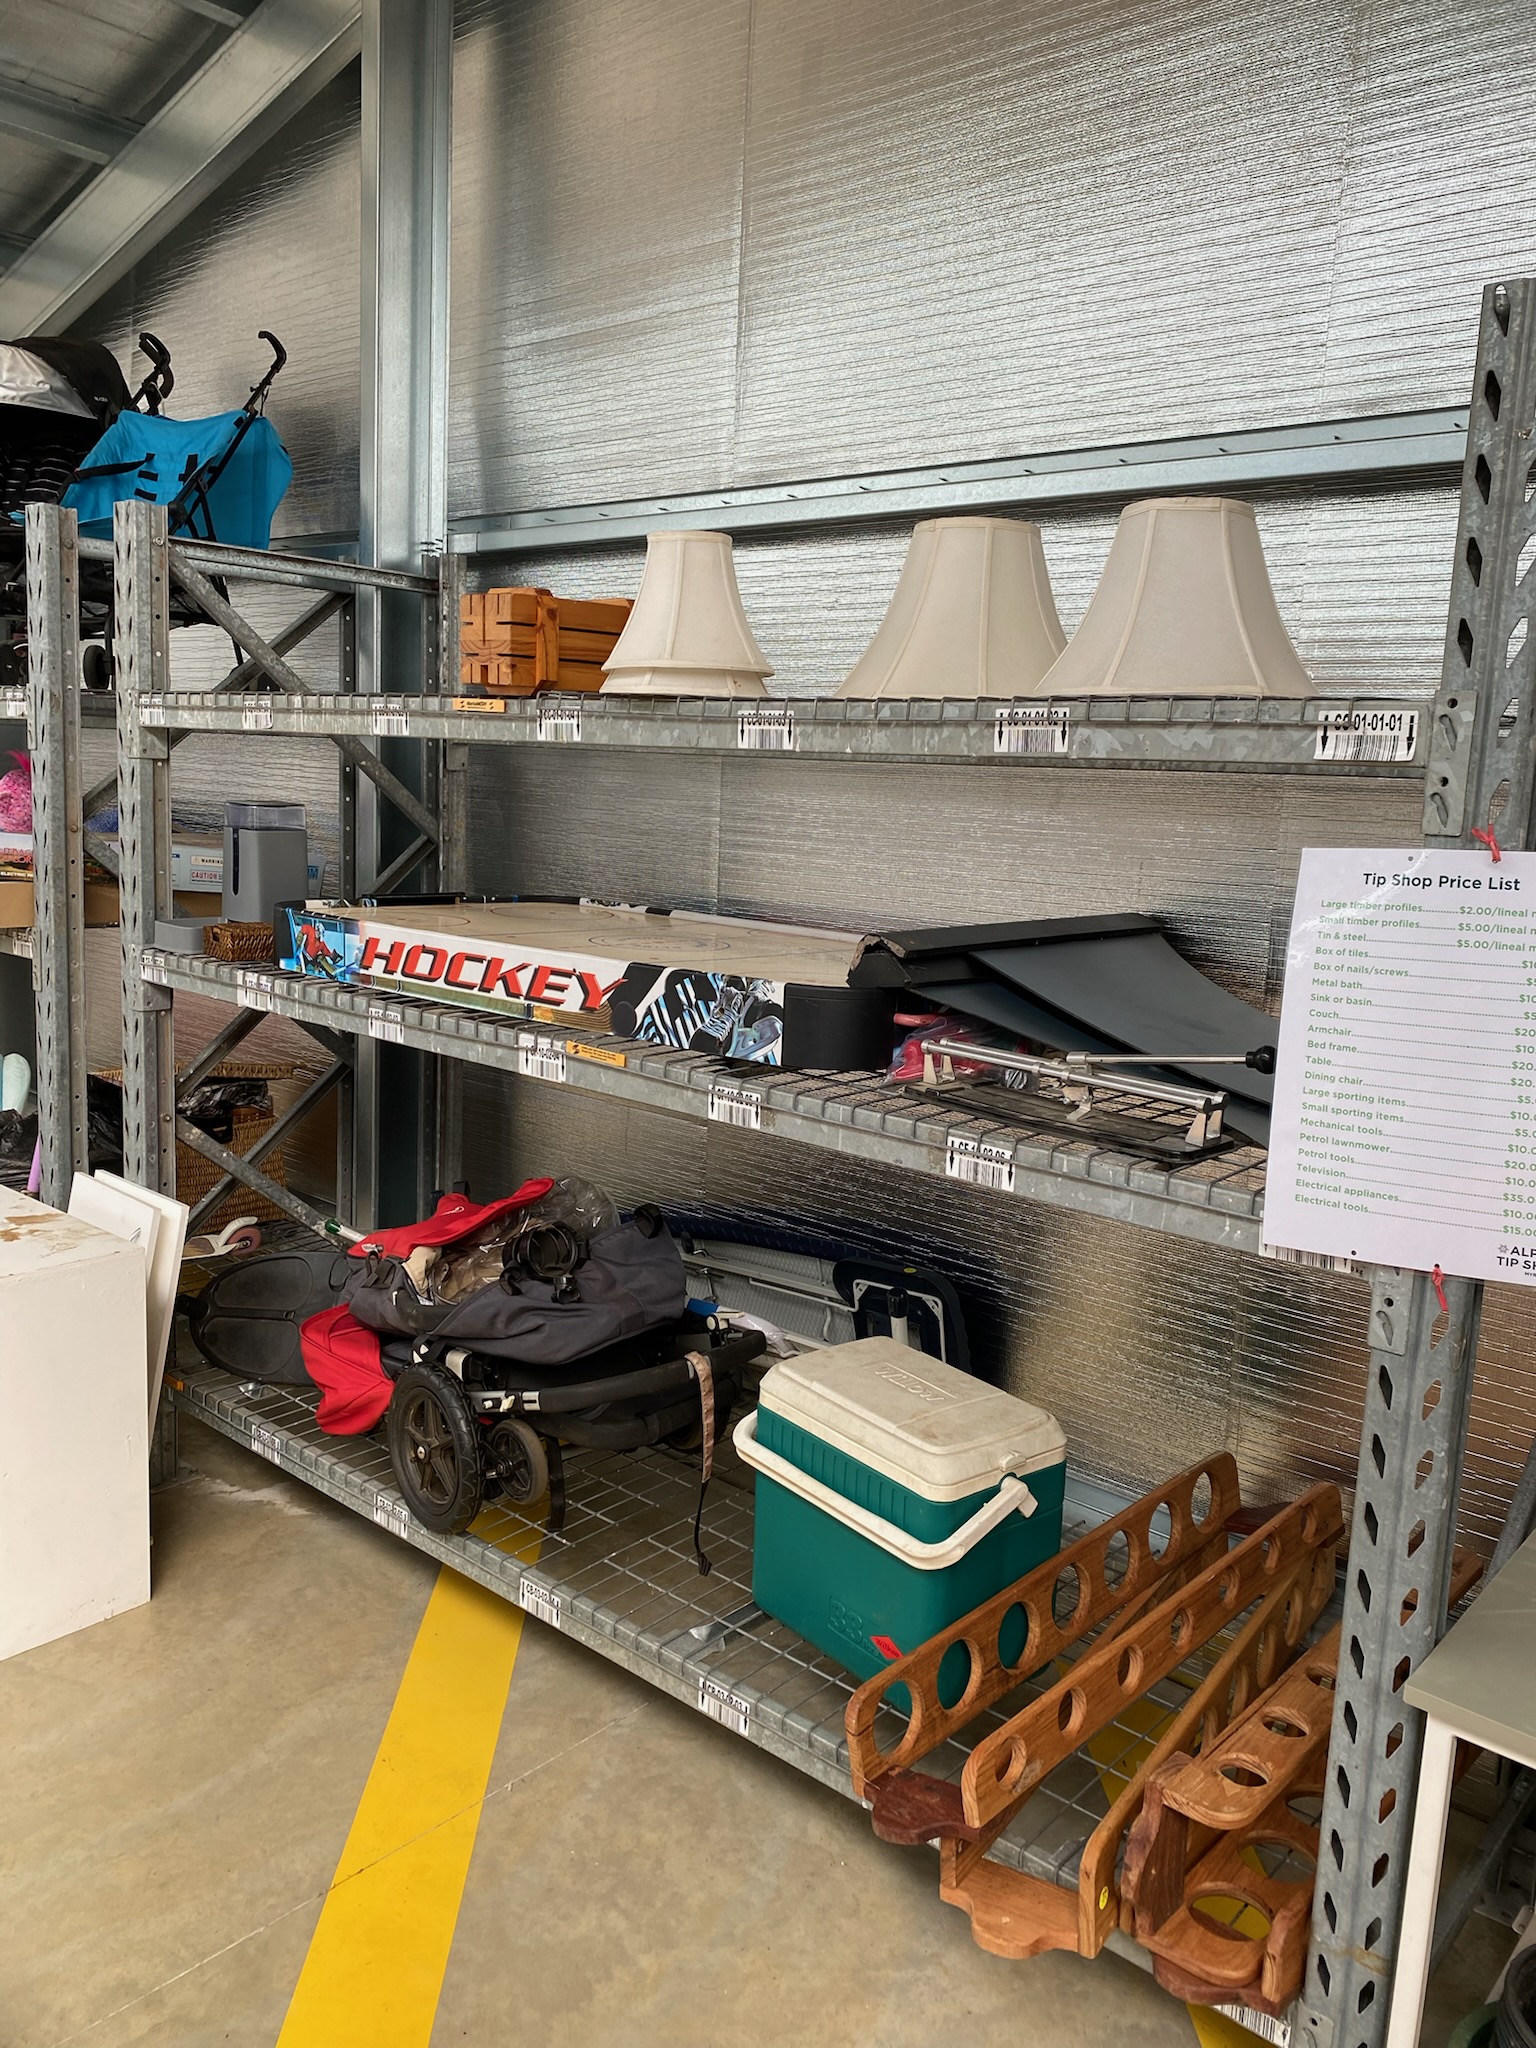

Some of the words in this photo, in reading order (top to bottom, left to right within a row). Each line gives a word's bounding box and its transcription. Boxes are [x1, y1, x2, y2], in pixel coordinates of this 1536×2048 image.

[1335, 713, 1403, 731] CC01-01-01
[191, 871, 217, 880] CAUTION
[1363, 873, 1386, 886] Tip
[1392, 875, 1432, 889] Shop
[1439, 875, 1482, 889] Price
[1488, 878, 1520, 890] List
[1321, 900, 1347, 910] Large
[1350, 901, 1382, 910] timber
[1384, 903, 1423, 912] profiles
[1459, 906, 1528, 917] $2.00/lineal
[1319, 915, 1345, 924] Small
[1347, 917, 1378, 926] timber
[1381, 919, 1420, 928] profiles
[1458, 923, 1526, 934] $5.00/lineal
[1343, 934, 1366, 942] steel
[1457, 940, 1525, 952] $5.00/lineal
[1316, 947, 1333, 956] Box
[1336, 948, 1346, 956] of
[1348, 949, 1368, 958] tiles
[1522, 960, 1536, 970] $1
[361, 936, 628, 1012] HOCKEY
[1314, 963, 1331, 971] Box
[1334, 964, 1344, 972] of
[1347, 965, 1408, 977] nails/screws
[1312, 978, 1337, 987] Metal
[1340, 980, 1362, 990] bath
[1311, 994, 1330, 1003] Sink
[1334, 996, 1344, 1004] or
[1346, 996, 1372, 1006] basin
[1309, 1009, 1339, 1019] Couch
[1308, 1025, 1351, 1036] Armchair
[1308, 1041, 1326, 1050] Bed
[1329, 1043, 1357, 1053] frame
[1306, 1056, 1332, 1066] Table
[1305, 1071, 1335, 1083] Dining
[1338, 1075, 1363, 1086] chair
[1518, 1095, 1536, 1105] $5.
[1303, 1087, 1330, 1098] Large
[1333, 1091, 1374, 1105] sporting
[1378, 1096, 1406, 1107] items
[1302, 1102, 1328, 1112] Small
[1331, 1106, 1372, 1120] sporting
[1376, 1112, 1404, 1122] items
[1301, 1118, 1354, 1132] Mechanical
[1358, 1126, 1383, 1136] tools
[1300, 1133, 1329, 1144] Petrol
[1332, 1137, 1390, 1153] lawnmower
[958, 1141, 1006, 1165] CF100206
[1298, 1148, 1327, 1159] Petrol
[1330, 1153, 1355, 1163] tools
[1297, 1164, 1346, 1179] Television
[1295, 1194, 1340, 1208] Electrical
[1344, 1202, 1369, 1213] tools
[1296, 1179, 1341, 1193] Electrical
[1344, 1186, 1399, 1202] appliances
[1503, 1209, 1536, 1220] $10.0
[1497, 1256, 1518, 1267] TIP
